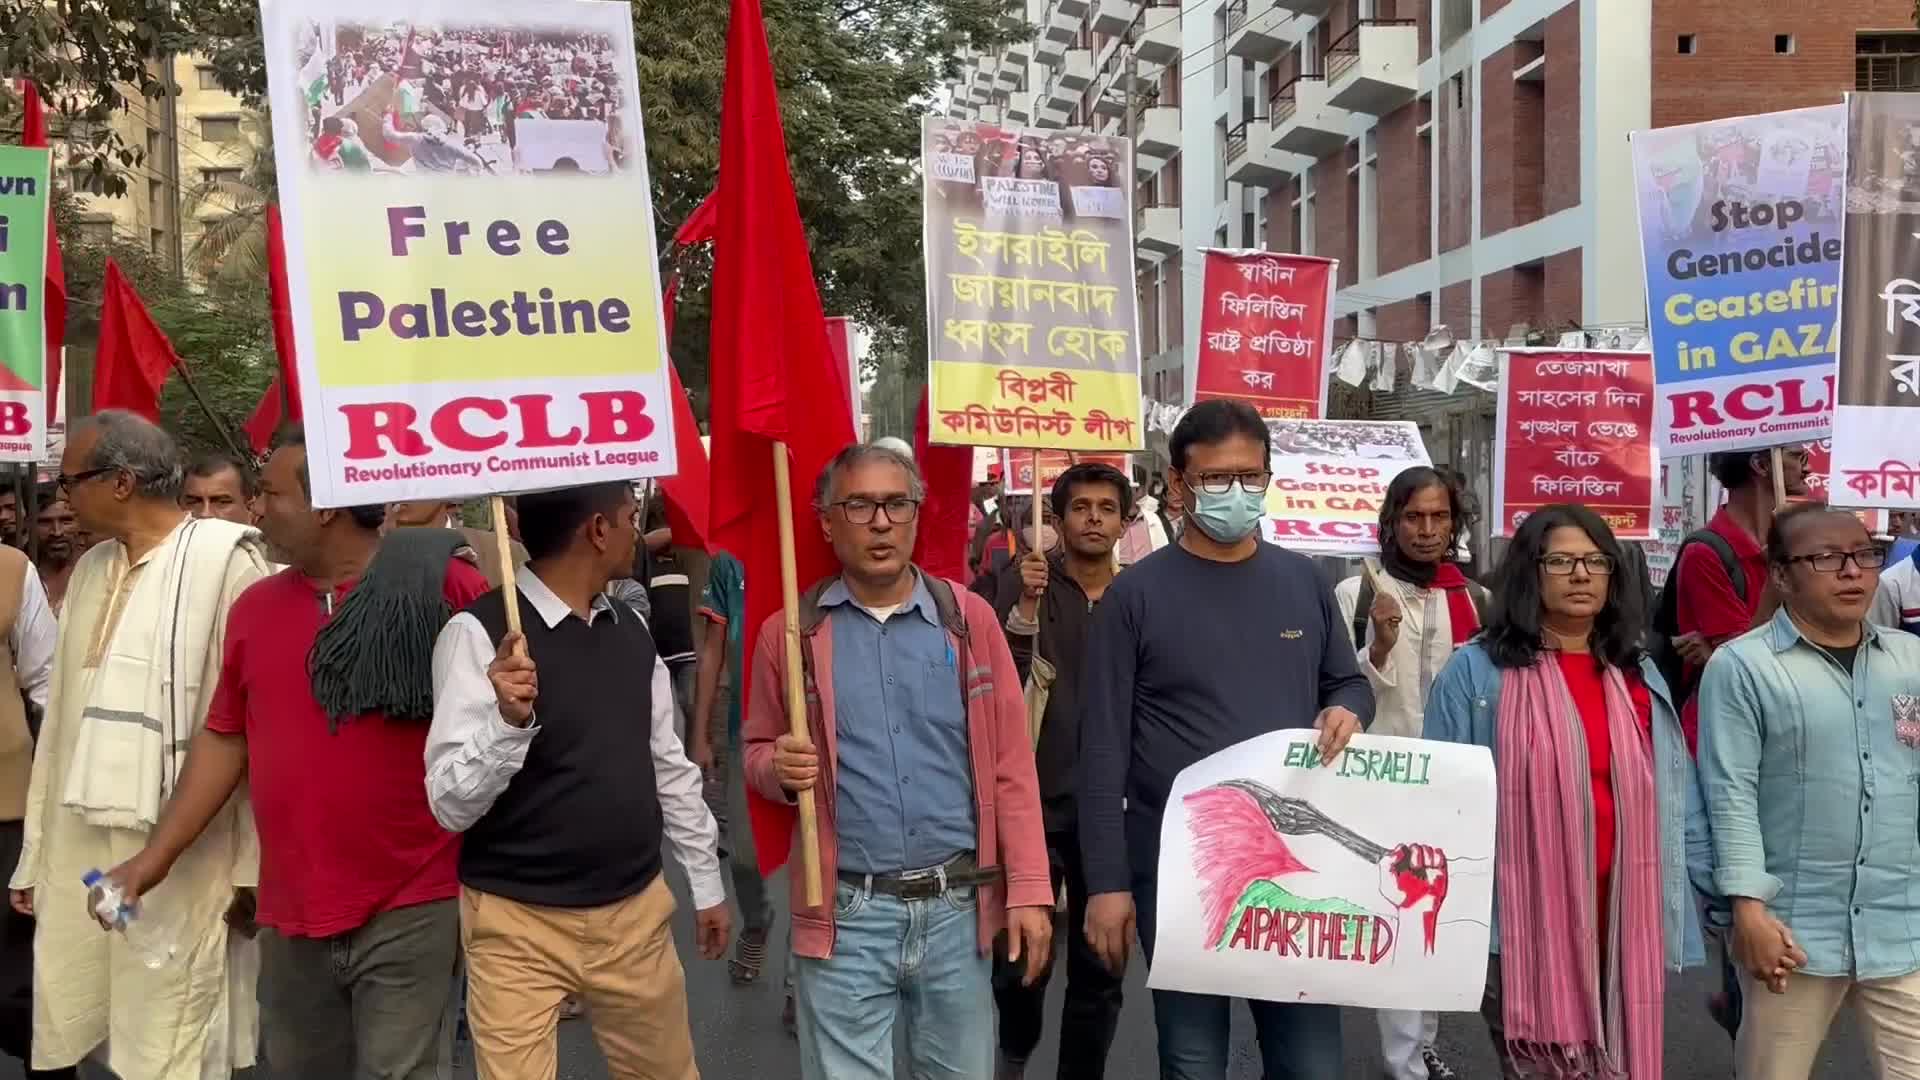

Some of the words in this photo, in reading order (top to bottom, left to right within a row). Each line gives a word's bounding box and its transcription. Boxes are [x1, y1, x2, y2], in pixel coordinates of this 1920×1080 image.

[387, 206, 570, 256] Free
[1711, 200, 1803, 232] Stop
[953, 218, 1111, 273] ইসরাইলি
[1667, 232, 1841, 280] Genocide
[1238, 258, 1296, 286] স্বাধীন
[338, 287, 631, 341] Palestine
[1220, 291, 1308, 322] ফিলিস্তিন
[1665, 278, 1837, 325] Ceasefir
[944, 318, 1036, 358] ধ্বংস
[1048, 325, 1129, 363] হোক
[1206, 327, 1245, 355] রাষ্ট্র
[1249, 330, 1316, 359] প্রতিষ্ঠা
[1677, 341, 1716, 372] in
[1241, 369, 1276, 390] কর
[1536, 358, 1630, 378] তেজমাখা
[995, 369, 1078, 403] বিপ্লবী
[1517, 389, 1599, 408] সাহসের
[1603, 386, 1645, 409] দিন
[338, 390, 655, 459] RCLB
[937, 404, 1076, 438] কমিউনিস্ট
[1082, 409, 1135, 444] লীগ
[1669, 425, 1756, 444] Revolutionary
[1759, 415, 1830, 434] Communist
[344, 460, 482, 483] Revolutionary
[487, 451, 590, 473] Communist
[595, 449, 659, 466] League
[1305, 462, 1379, 478] Stop
[1553, 445, 1604, 468] বাঁচে
[1275, 478, 1388, 495] Genoci
[1531, 475, 1623, 497] ফিলিস্তিন
[1286, 496, 1316, 509] in
[1325, 497, 1382, 513] GA
[1335, 747, 1431, 785] ISRAELI
[1229, 905, 1393, 965] APARTHEID
